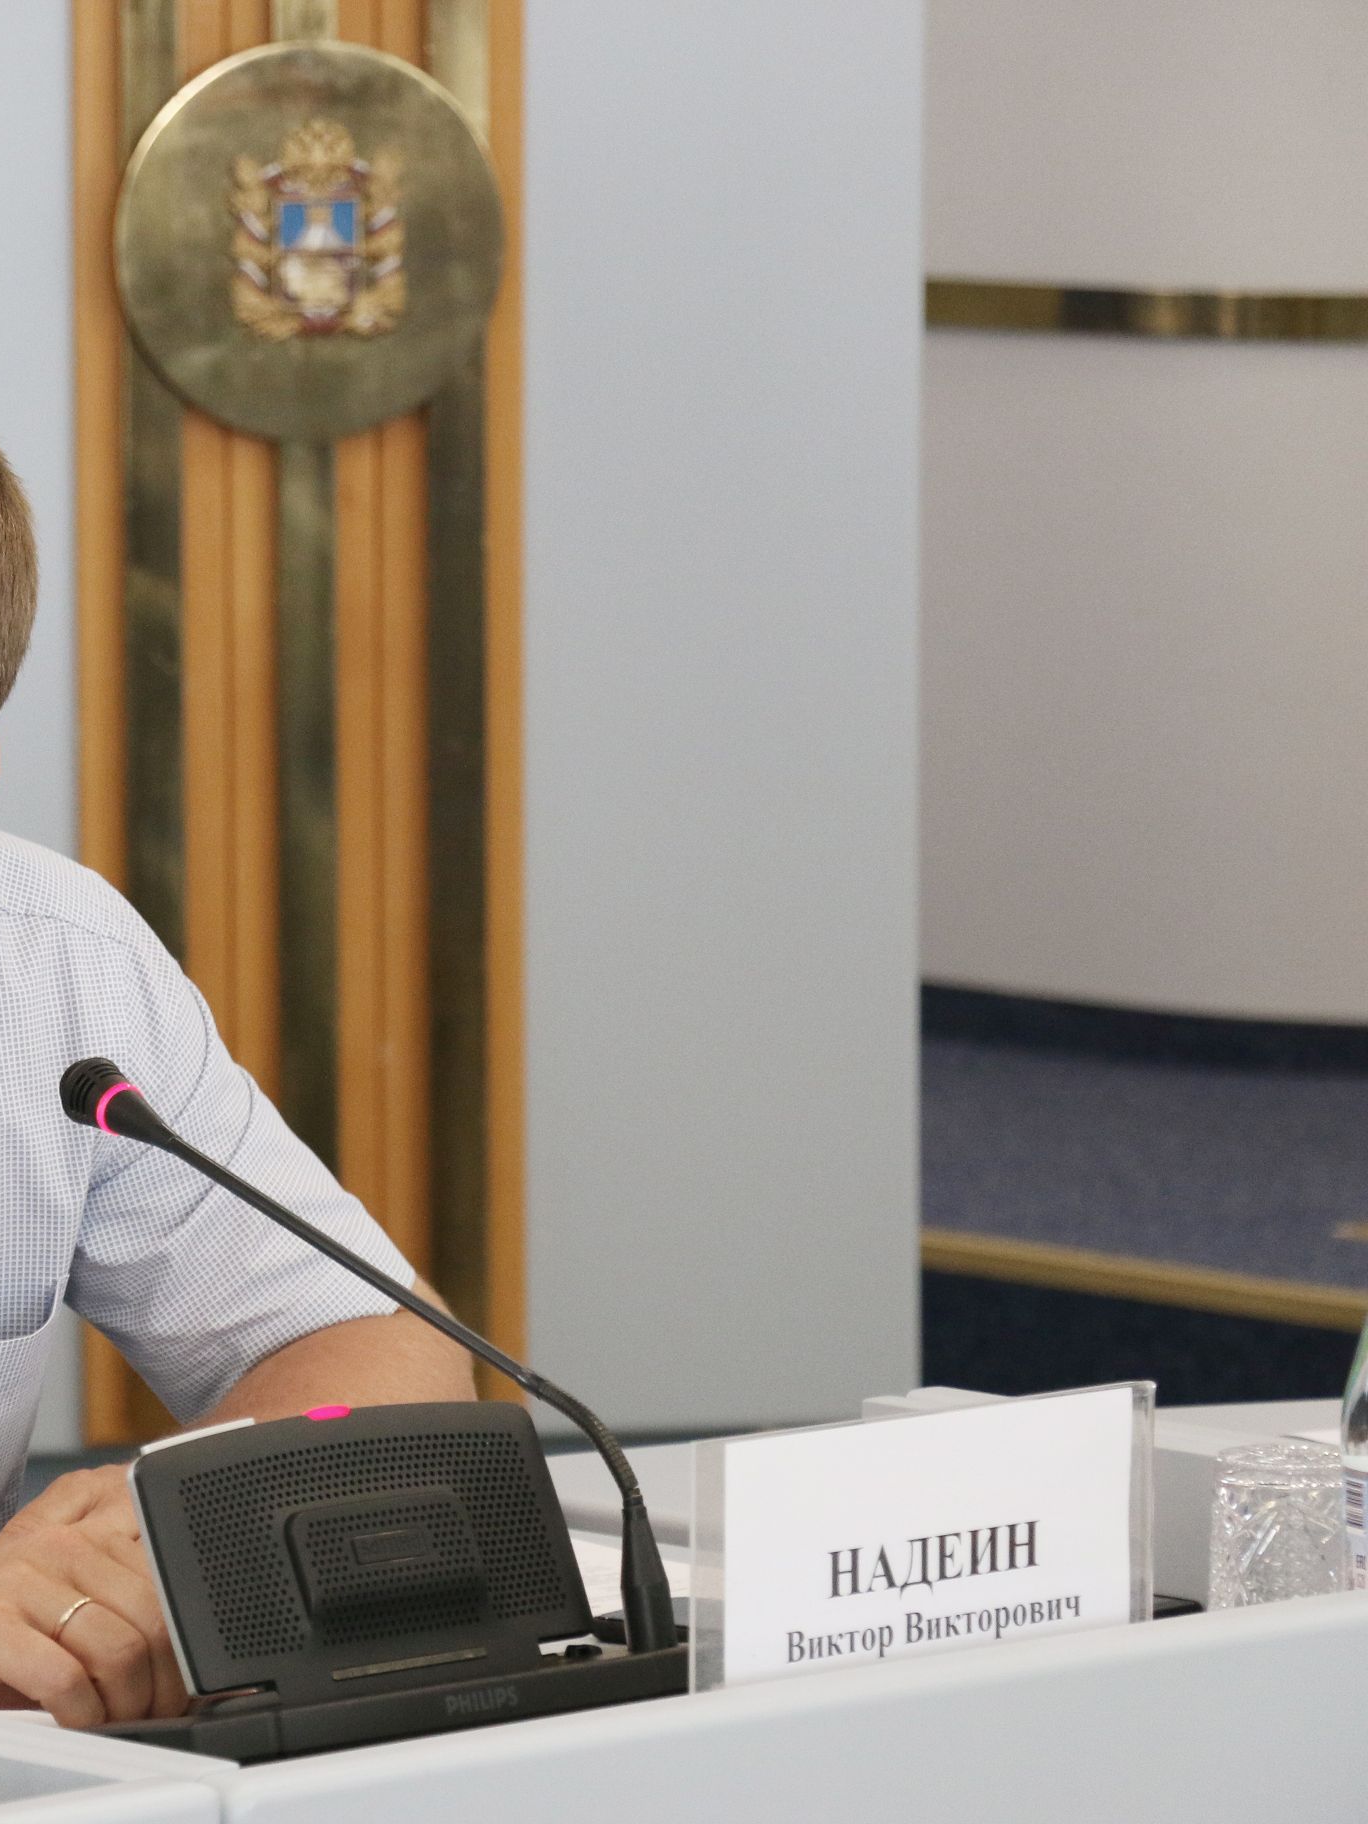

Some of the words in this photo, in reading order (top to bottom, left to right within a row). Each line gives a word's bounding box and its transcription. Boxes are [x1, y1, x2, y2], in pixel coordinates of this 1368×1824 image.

[827, 1519, 1040, 1600] НАДЕИН
[785, 1623, 894, 1664] Виктор
[905, 1595, 1082, 1644] Викторович
[445, 1685, 519, 1716] PHILIPS
